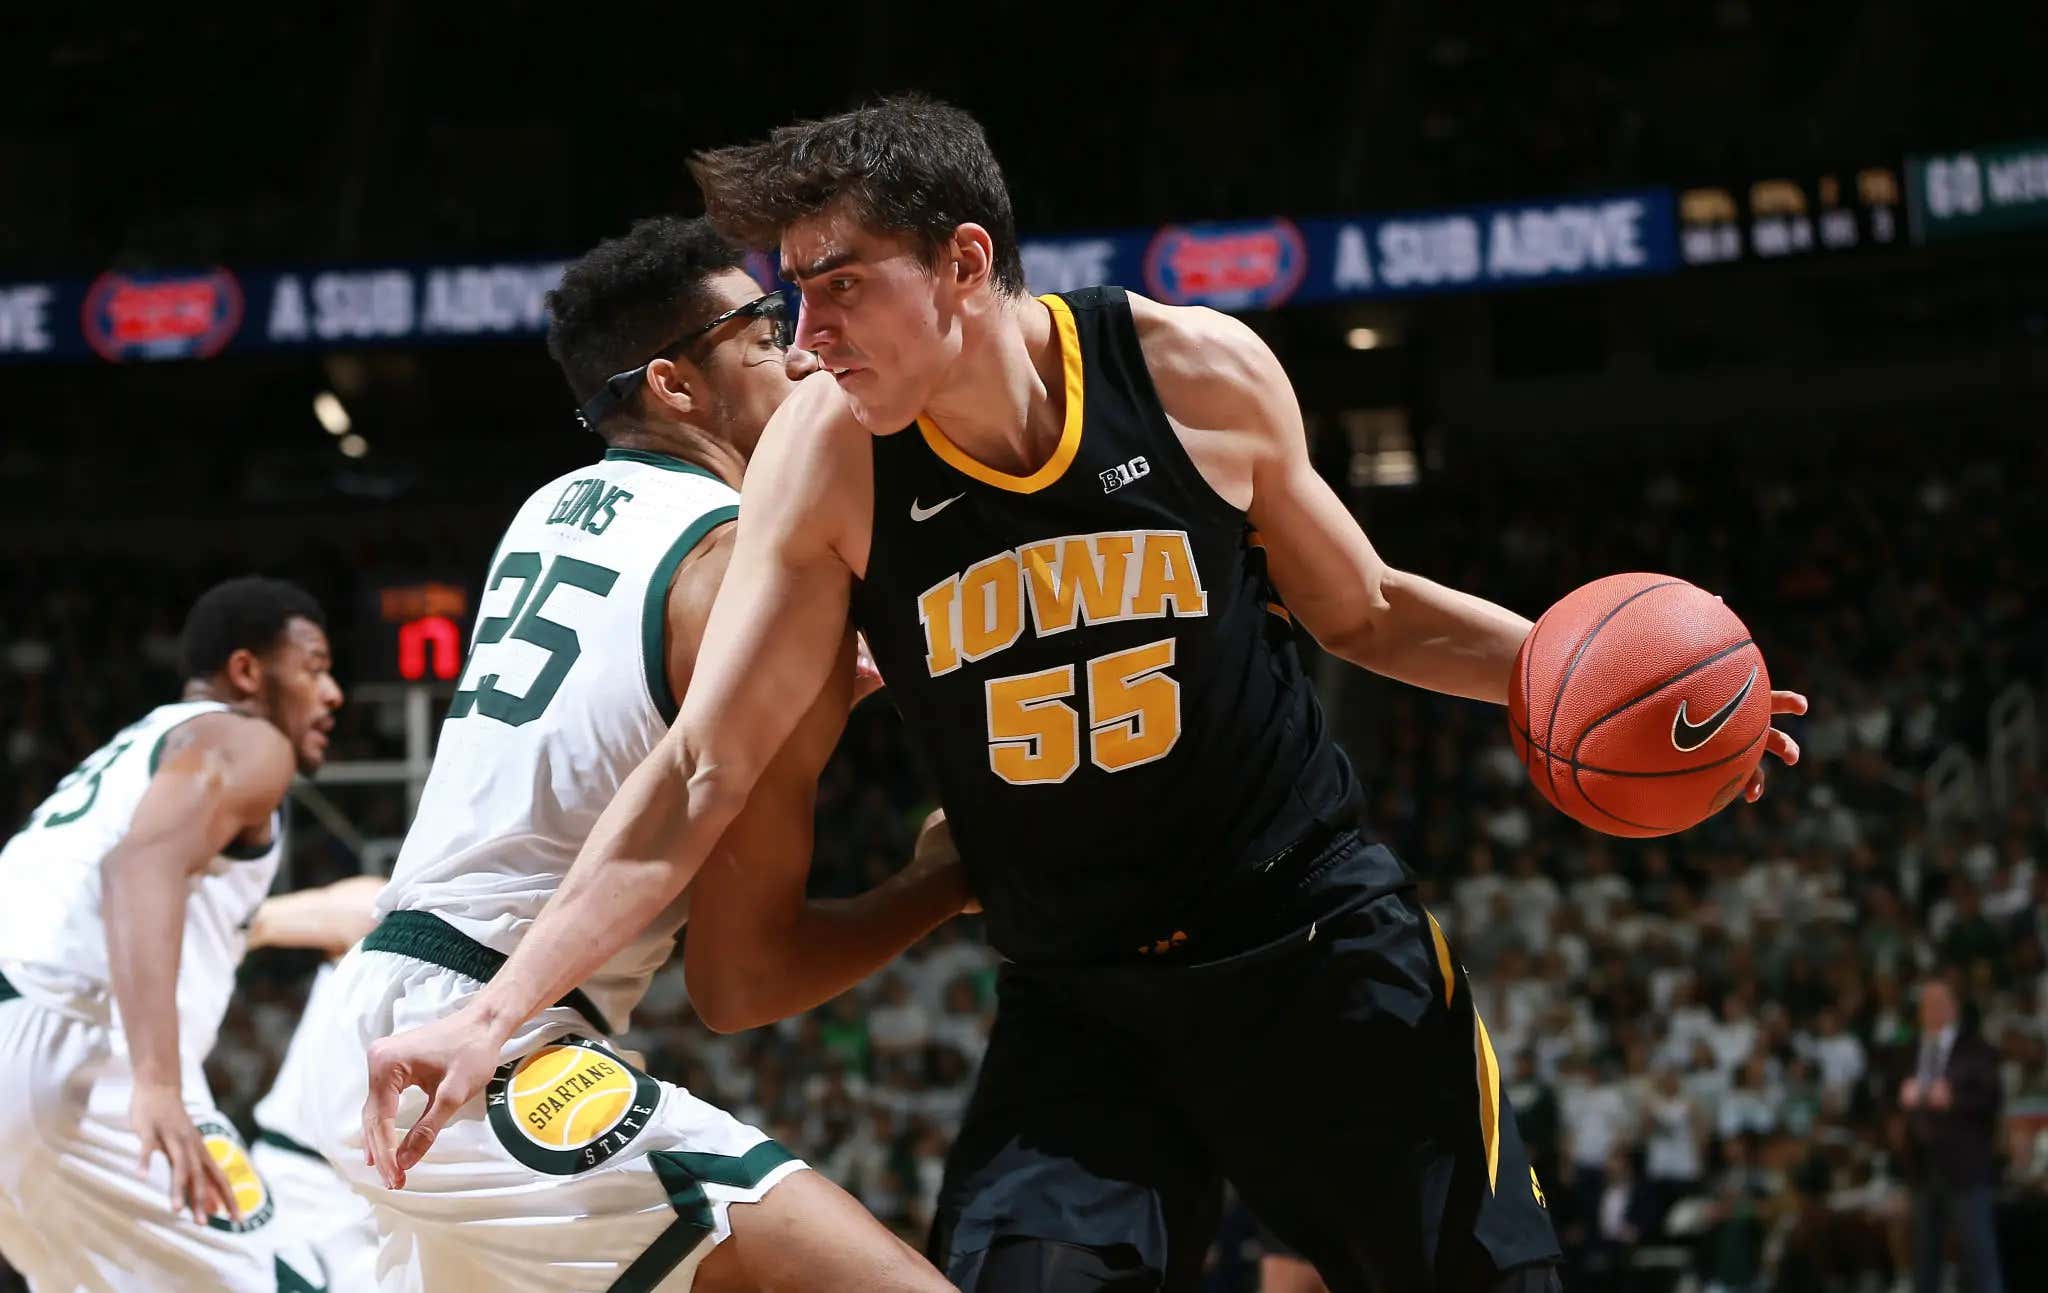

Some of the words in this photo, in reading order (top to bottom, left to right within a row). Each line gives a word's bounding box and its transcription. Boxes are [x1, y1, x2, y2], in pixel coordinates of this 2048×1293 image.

[1019, 241, 1113, 293] OVE
[1334, 225, 1373, 290] A
[1378, 215, 1479, 286] SUB
[1488, 200, 1645, 278] ABOVE
[269, 273, 307, 340] A
[312, 268, 414, 338] SUB
[545, 478, 634, 536] GOINS
[918, 529, 1208, 678] IOWA
[445, 552, 621, 728] 25
[984, 637, 1182, 785] 55
[528, 1061, 616, 1131] SPARTANS
[584, 1104, 652, 1166] STATE
